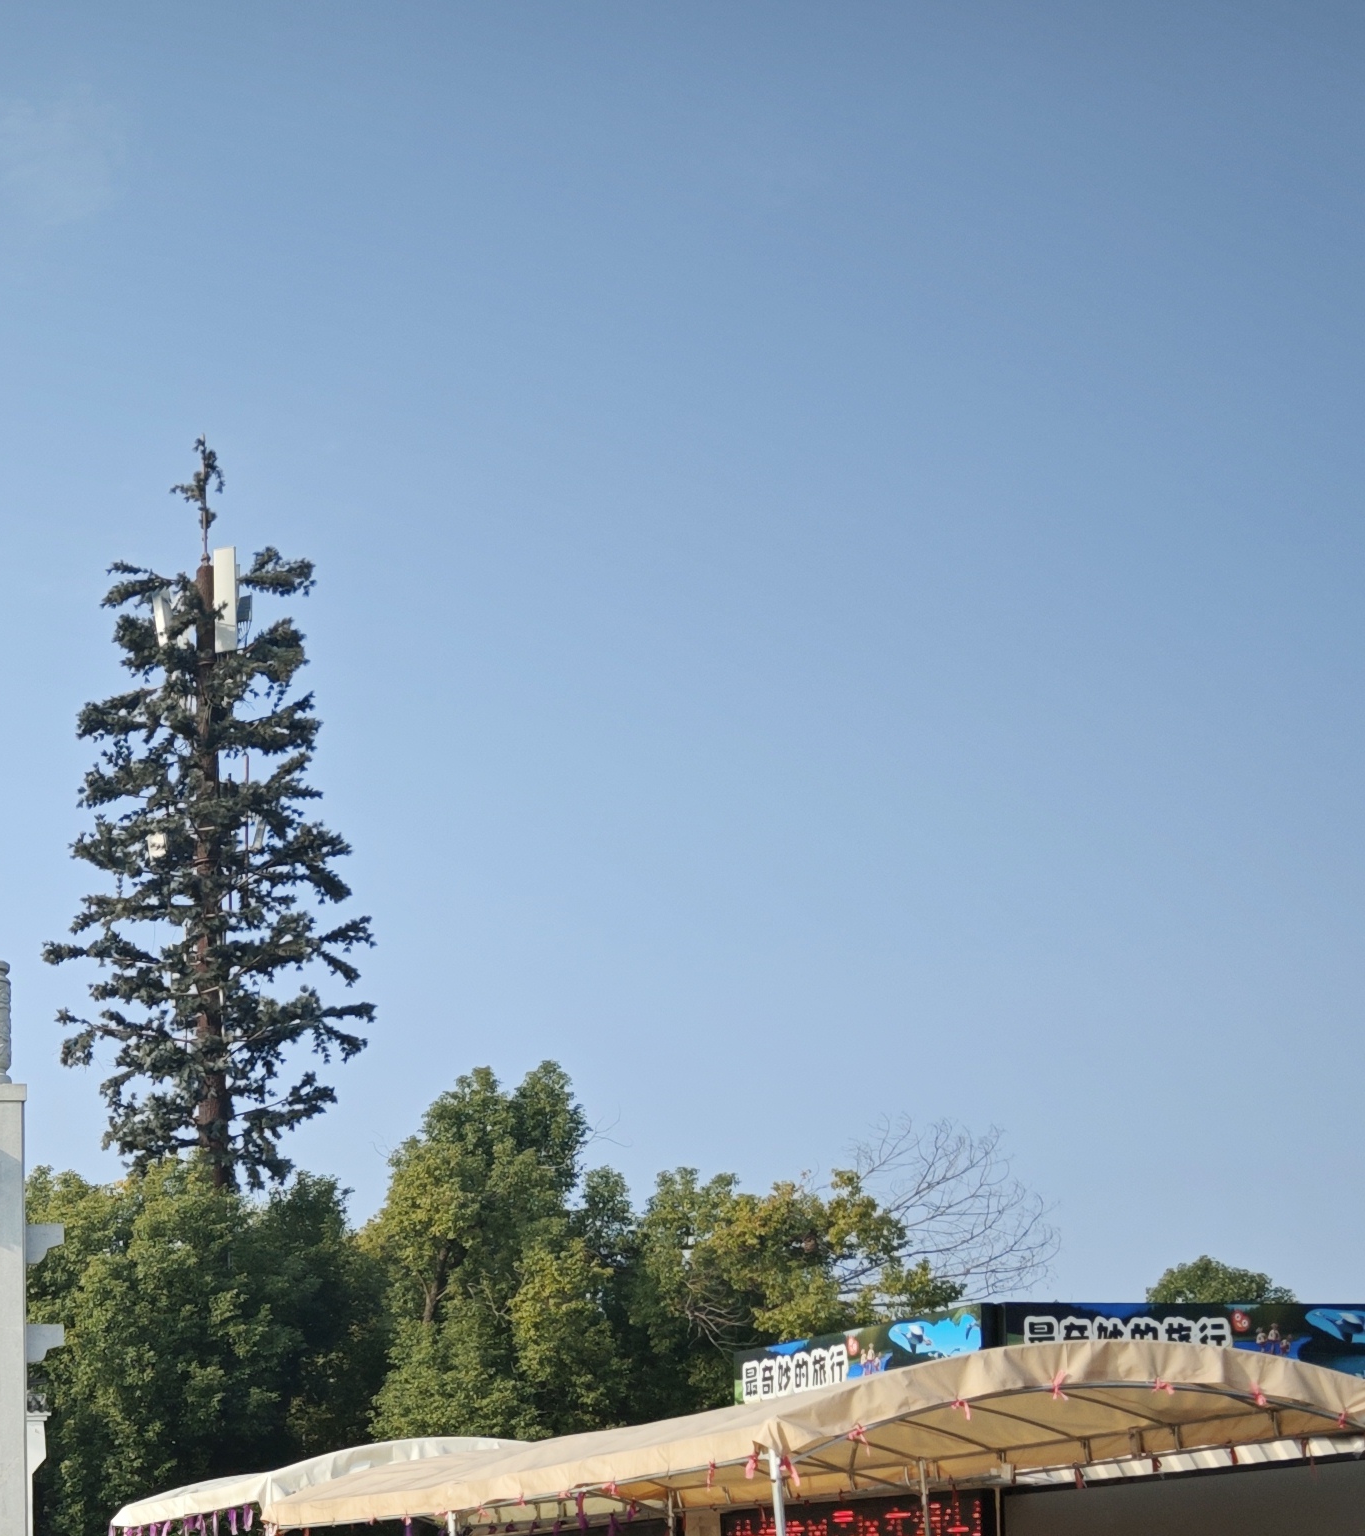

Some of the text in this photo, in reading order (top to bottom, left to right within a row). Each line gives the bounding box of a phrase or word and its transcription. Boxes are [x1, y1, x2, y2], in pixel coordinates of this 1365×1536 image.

[743, 1344, 848, 1401] 最奇妙的旅行
